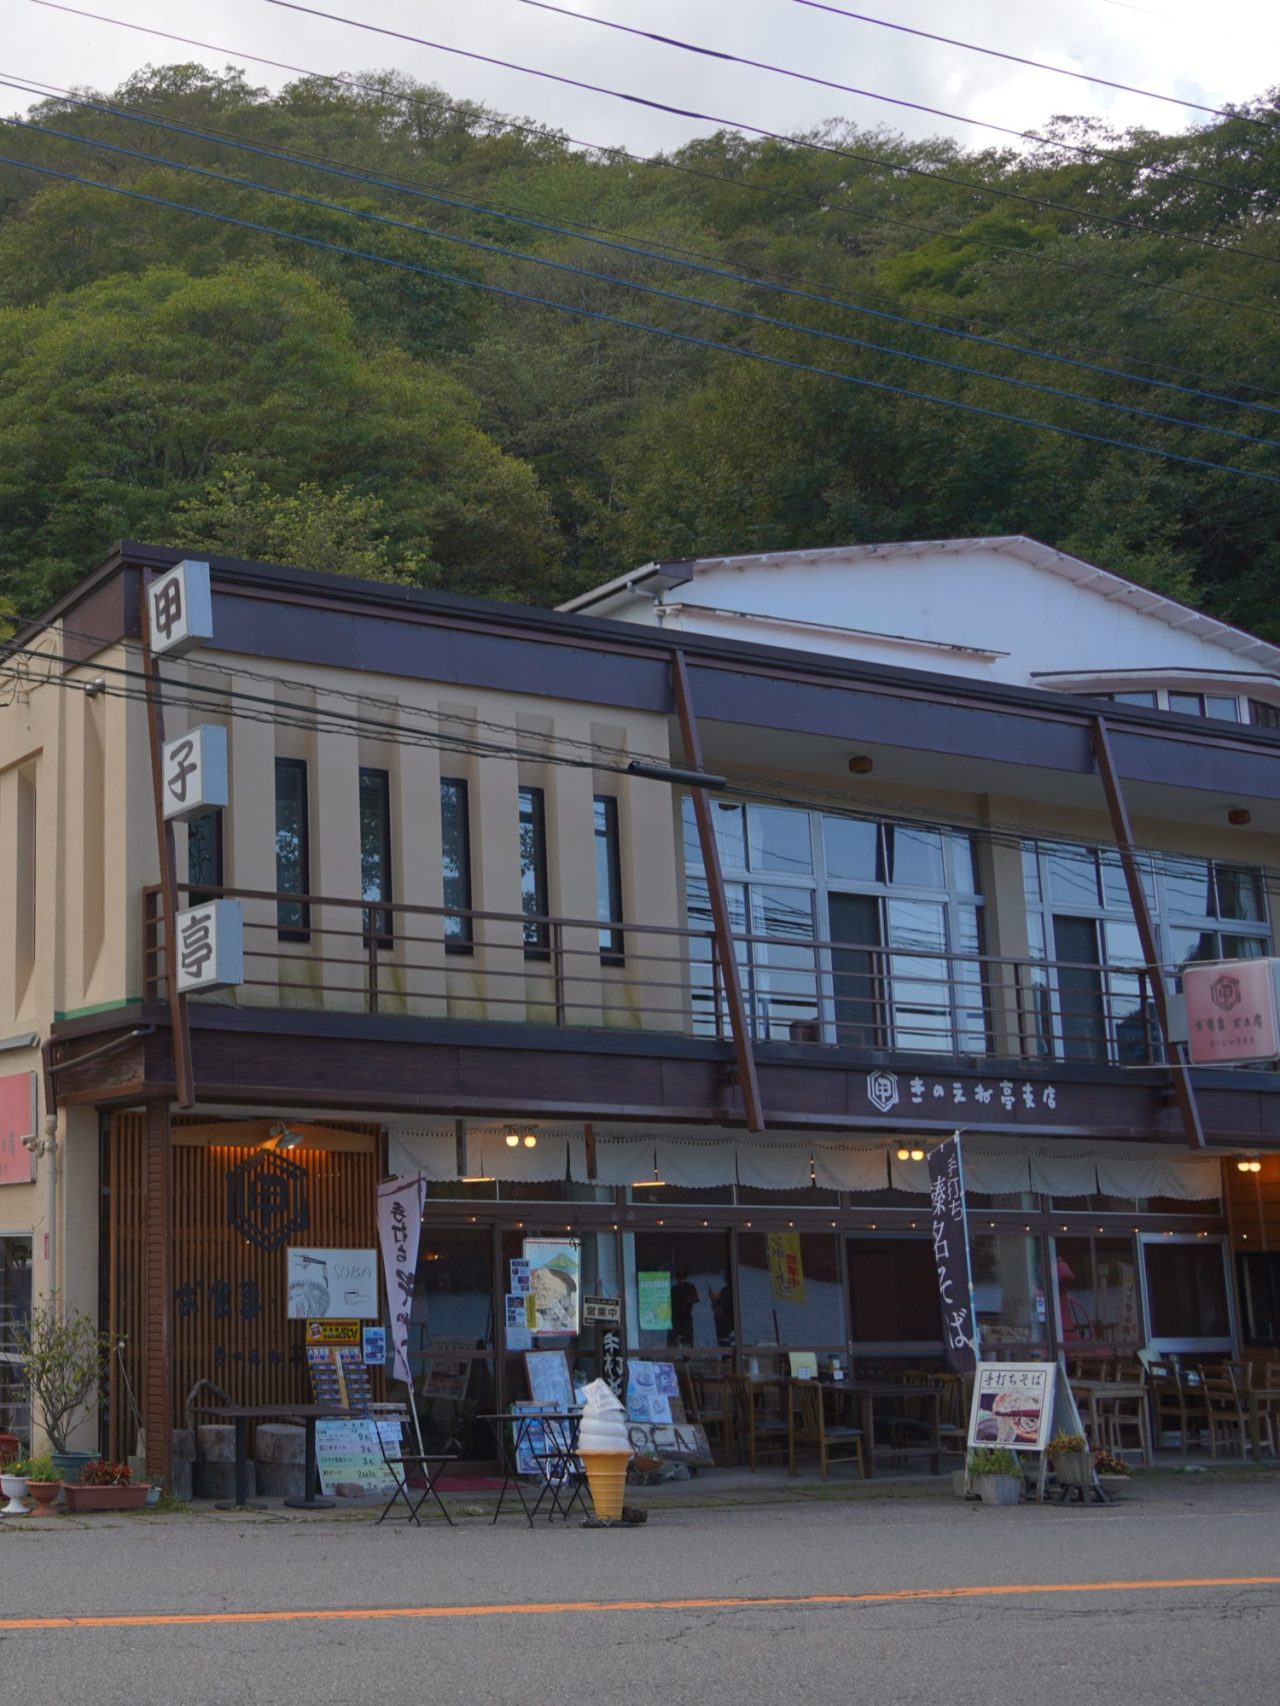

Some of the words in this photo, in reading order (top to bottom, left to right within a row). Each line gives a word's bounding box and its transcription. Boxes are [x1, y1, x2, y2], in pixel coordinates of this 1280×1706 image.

[154, 576, 182, 640] 甲
[167, 738, 198, 802] 子
[180, 912, 213, 980] 亭
[332, 1263, 372, 1281] SOBA
[586, 1304, 618, 1318] 営業中
[984, 1372, 1044, 1386] 手打ちそば
